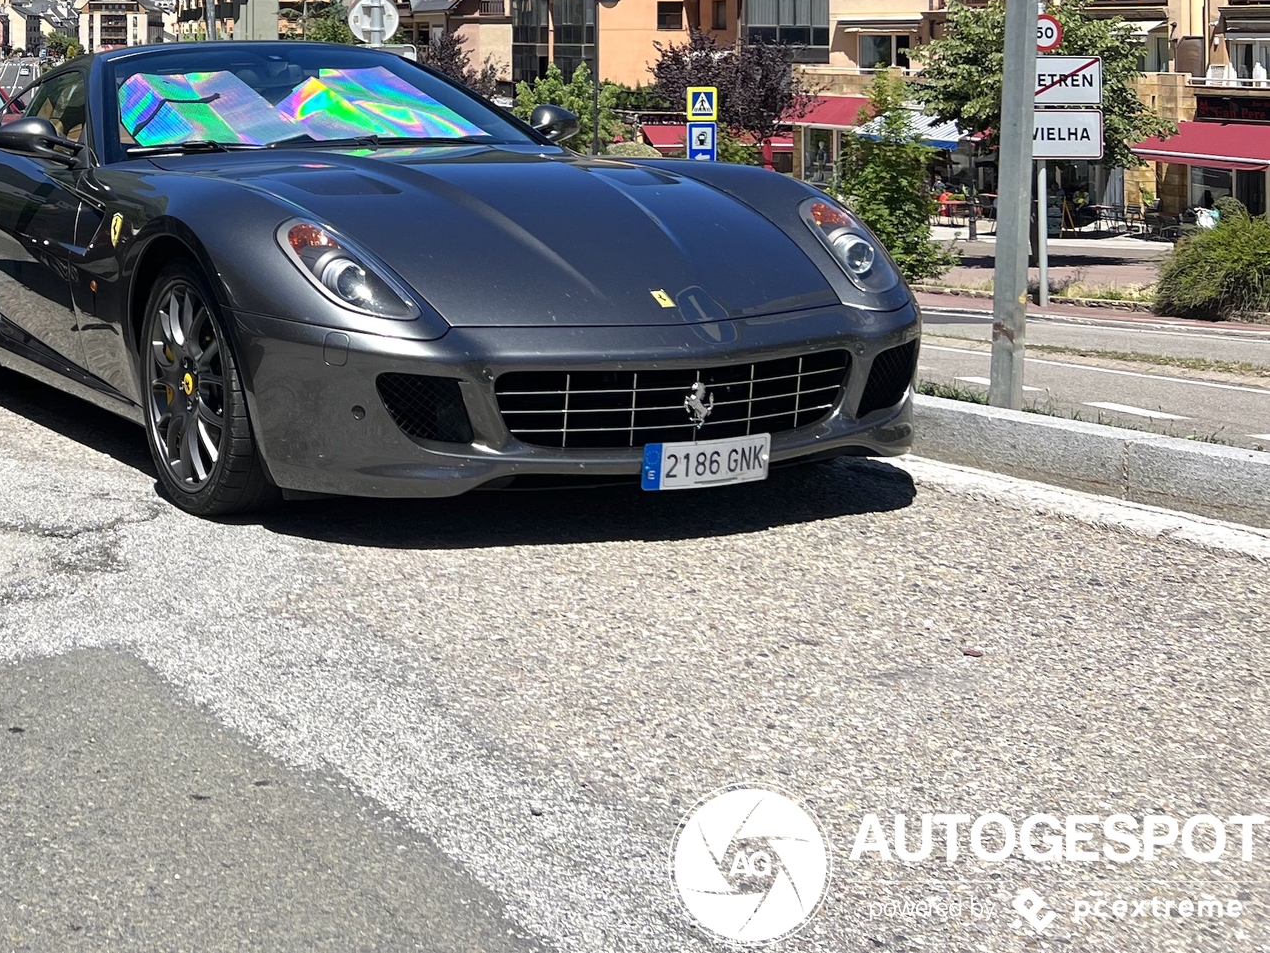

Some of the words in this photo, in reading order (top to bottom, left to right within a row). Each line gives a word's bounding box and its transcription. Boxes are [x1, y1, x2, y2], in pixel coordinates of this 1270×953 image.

[1037, 27, 1054, 39] 50
[1241, 108, 1266, 119] Pere
[1033, 128, 1091, 141] VIELHA
[647, 470, 656, 480] E
[665, 451, 721, 479] 2186
[727, 445, 764, 473] GNK
